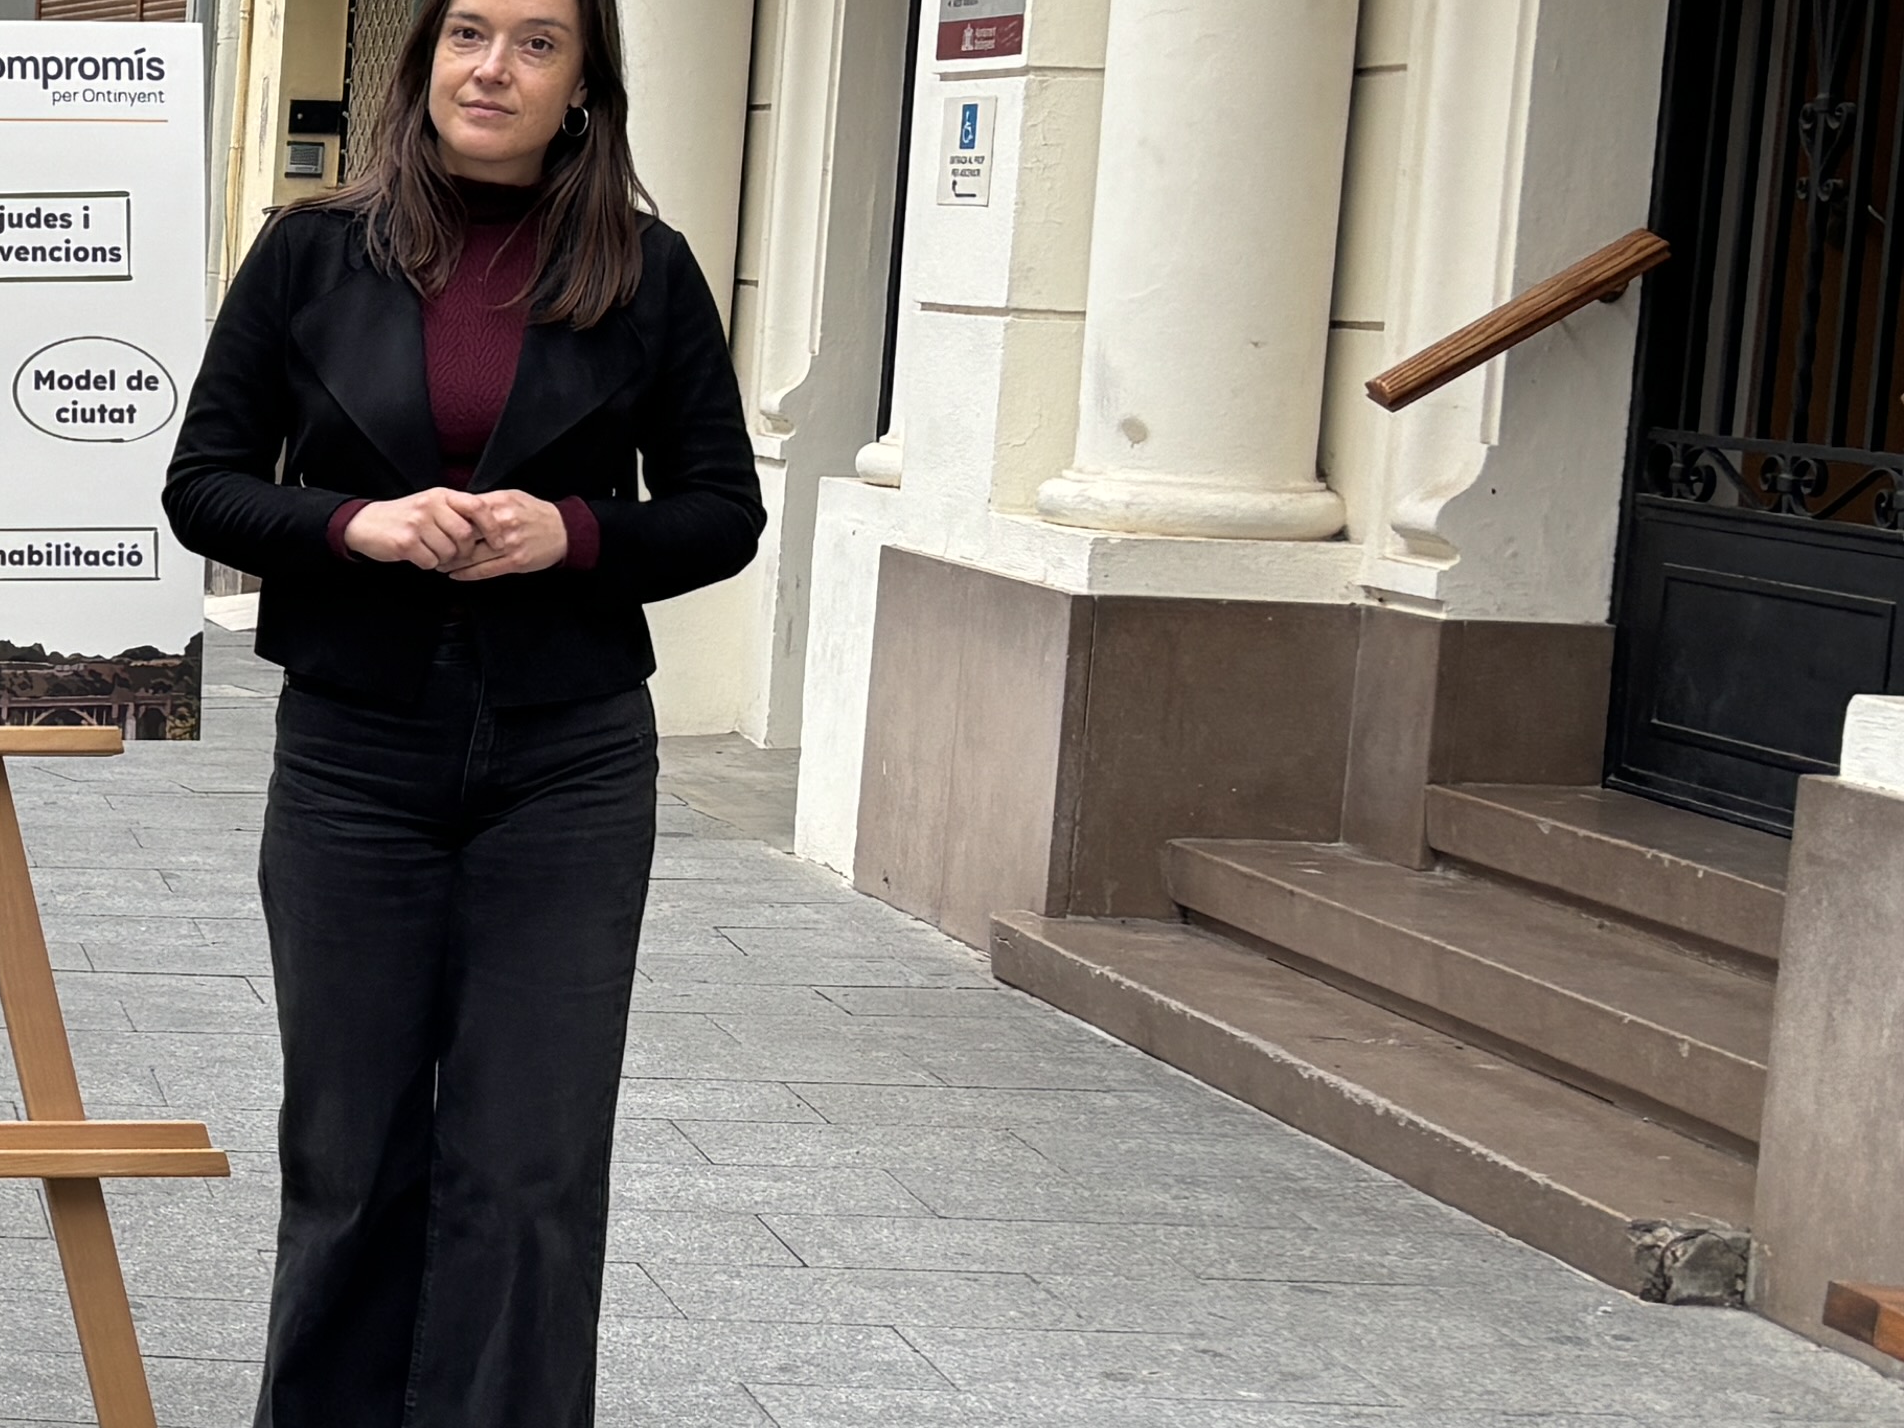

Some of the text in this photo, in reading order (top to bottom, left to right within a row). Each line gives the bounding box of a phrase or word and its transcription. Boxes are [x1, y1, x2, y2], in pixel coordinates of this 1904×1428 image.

[52, 88, 165, 107] per Ontinyent
[82, 205, 90, 229] i
[33, 368, 160, 392] Model de
[55, 400, 137, 425] ciutat
